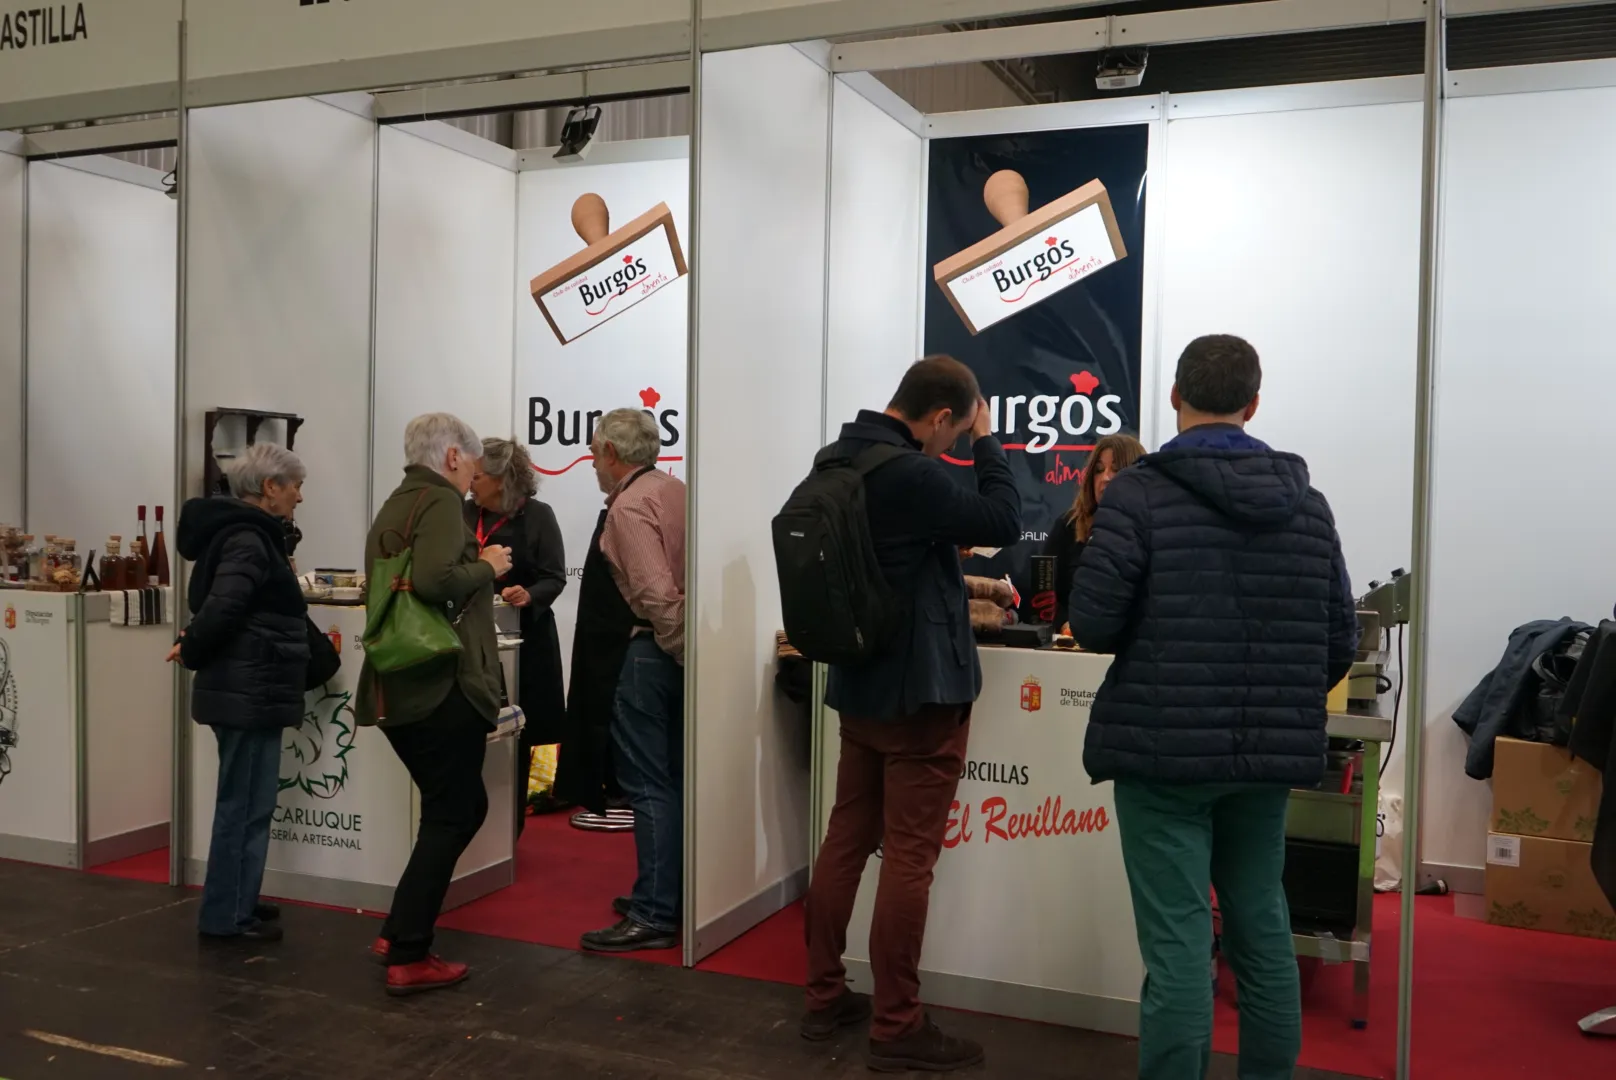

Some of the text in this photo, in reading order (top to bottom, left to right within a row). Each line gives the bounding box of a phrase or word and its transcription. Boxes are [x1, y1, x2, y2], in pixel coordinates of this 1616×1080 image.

[0, 2, 88, 50] ASTILLA
[578, 257, 647, 306] Burgos
[992, 239, 1075, 293] Burgos
[528, 396, 680, 447] Burs
[1045, 453, 1087, 486] alim
[1060, 697, 1071, 706] de
[271, 804, 362, 832] CARLUQUE
[302, 833, 362, 850] ARTESANAL
[942, 795, 1109, 849] El Revillano
